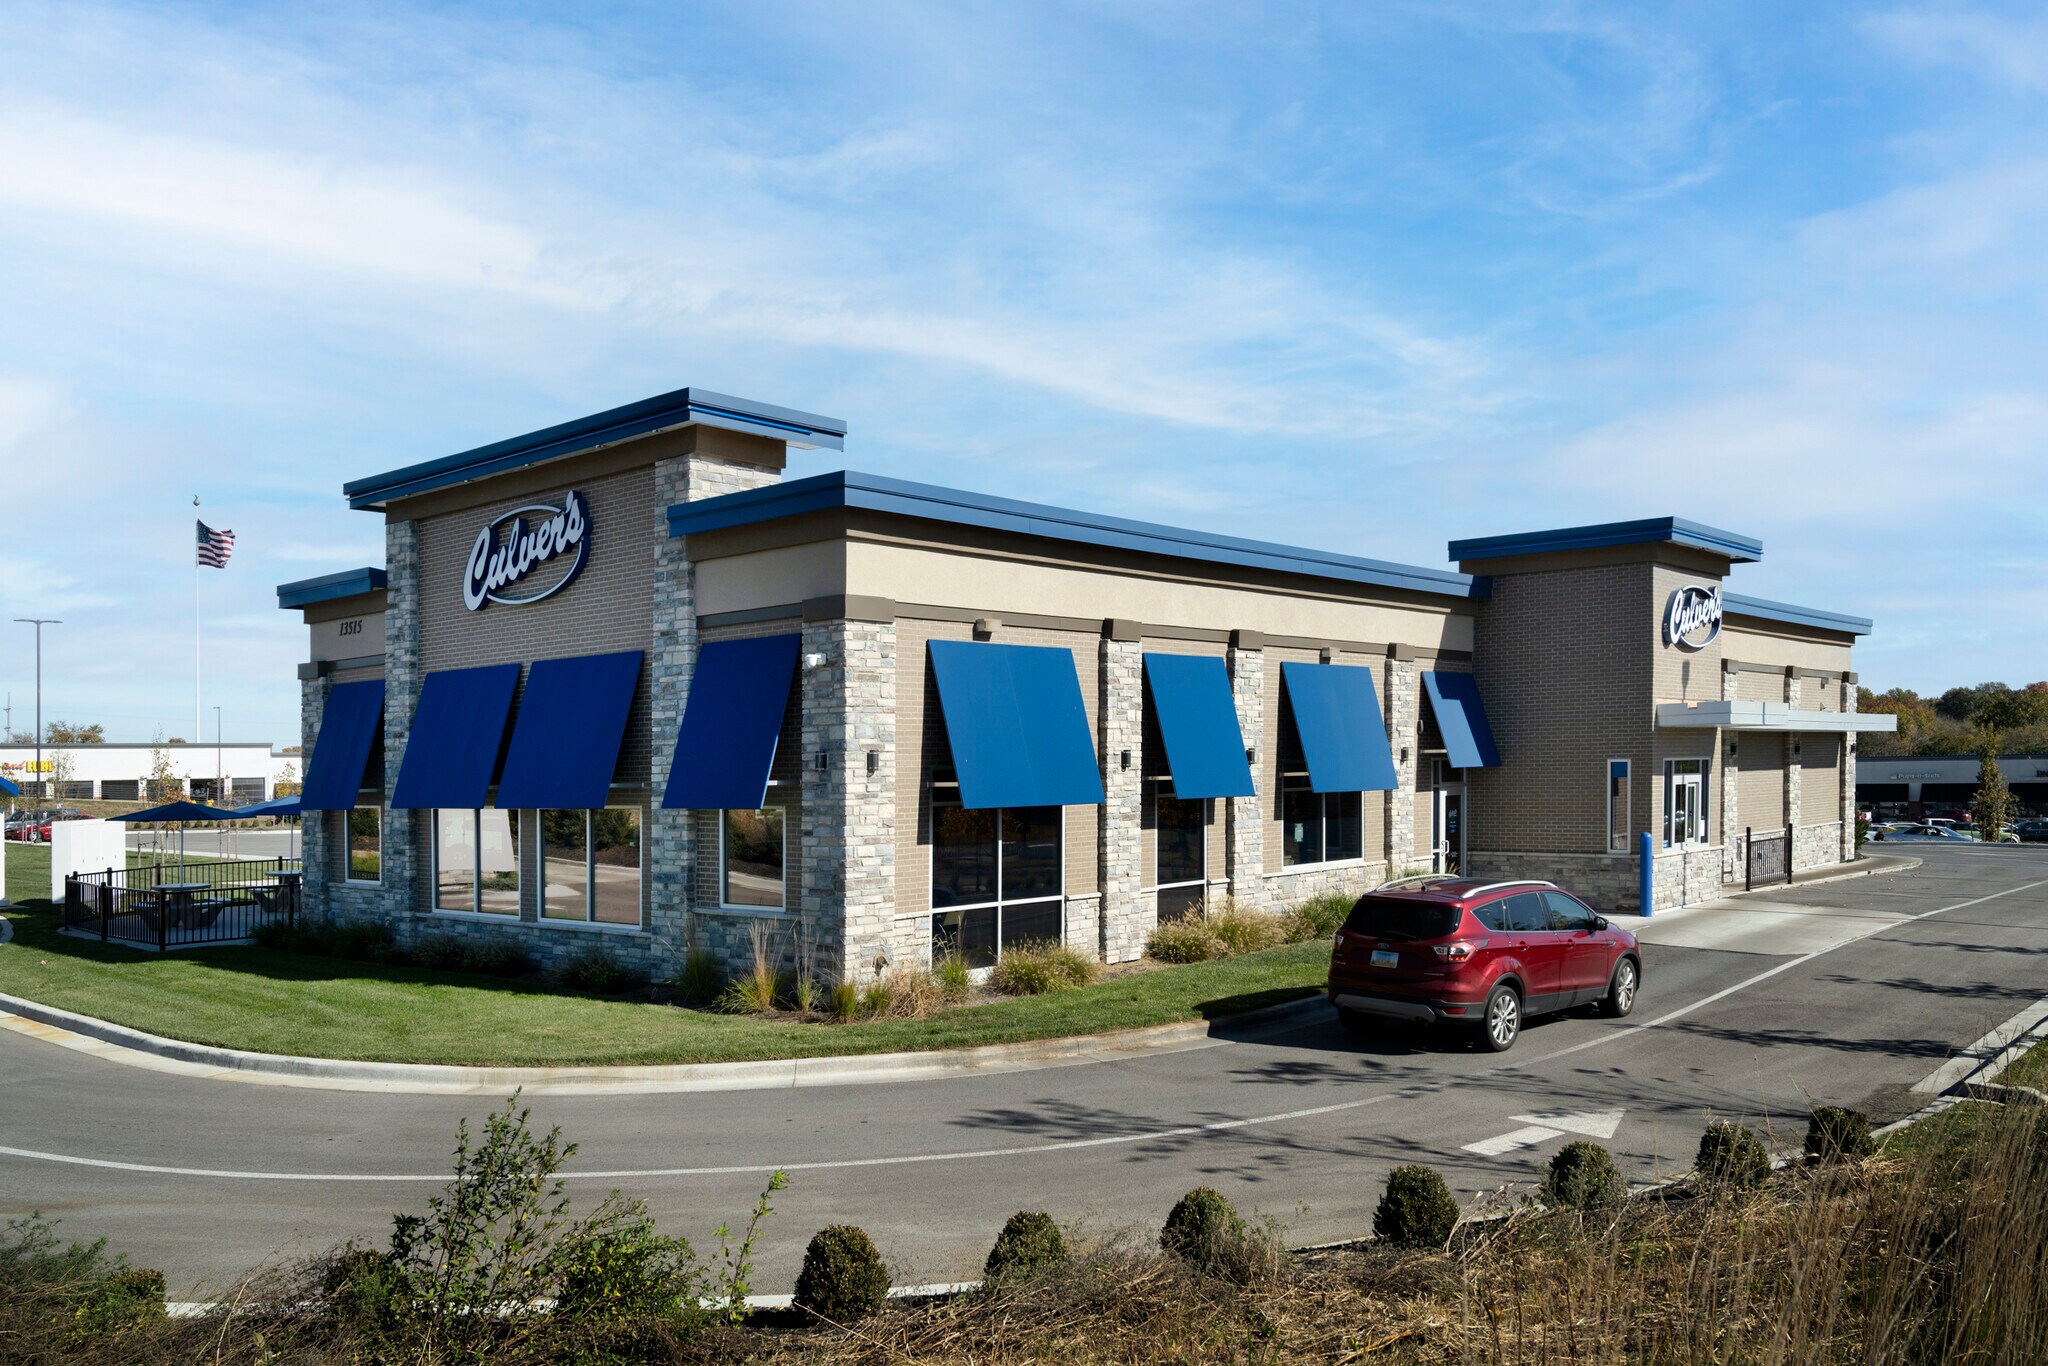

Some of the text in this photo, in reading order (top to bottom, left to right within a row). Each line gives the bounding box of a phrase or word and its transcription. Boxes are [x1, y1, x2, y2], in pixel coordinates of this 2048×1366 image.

[463, 490, 585, 611] Culver's
[339, 620, 363, 636] 13515
[1669, 586, 1723, 644] Culver's
